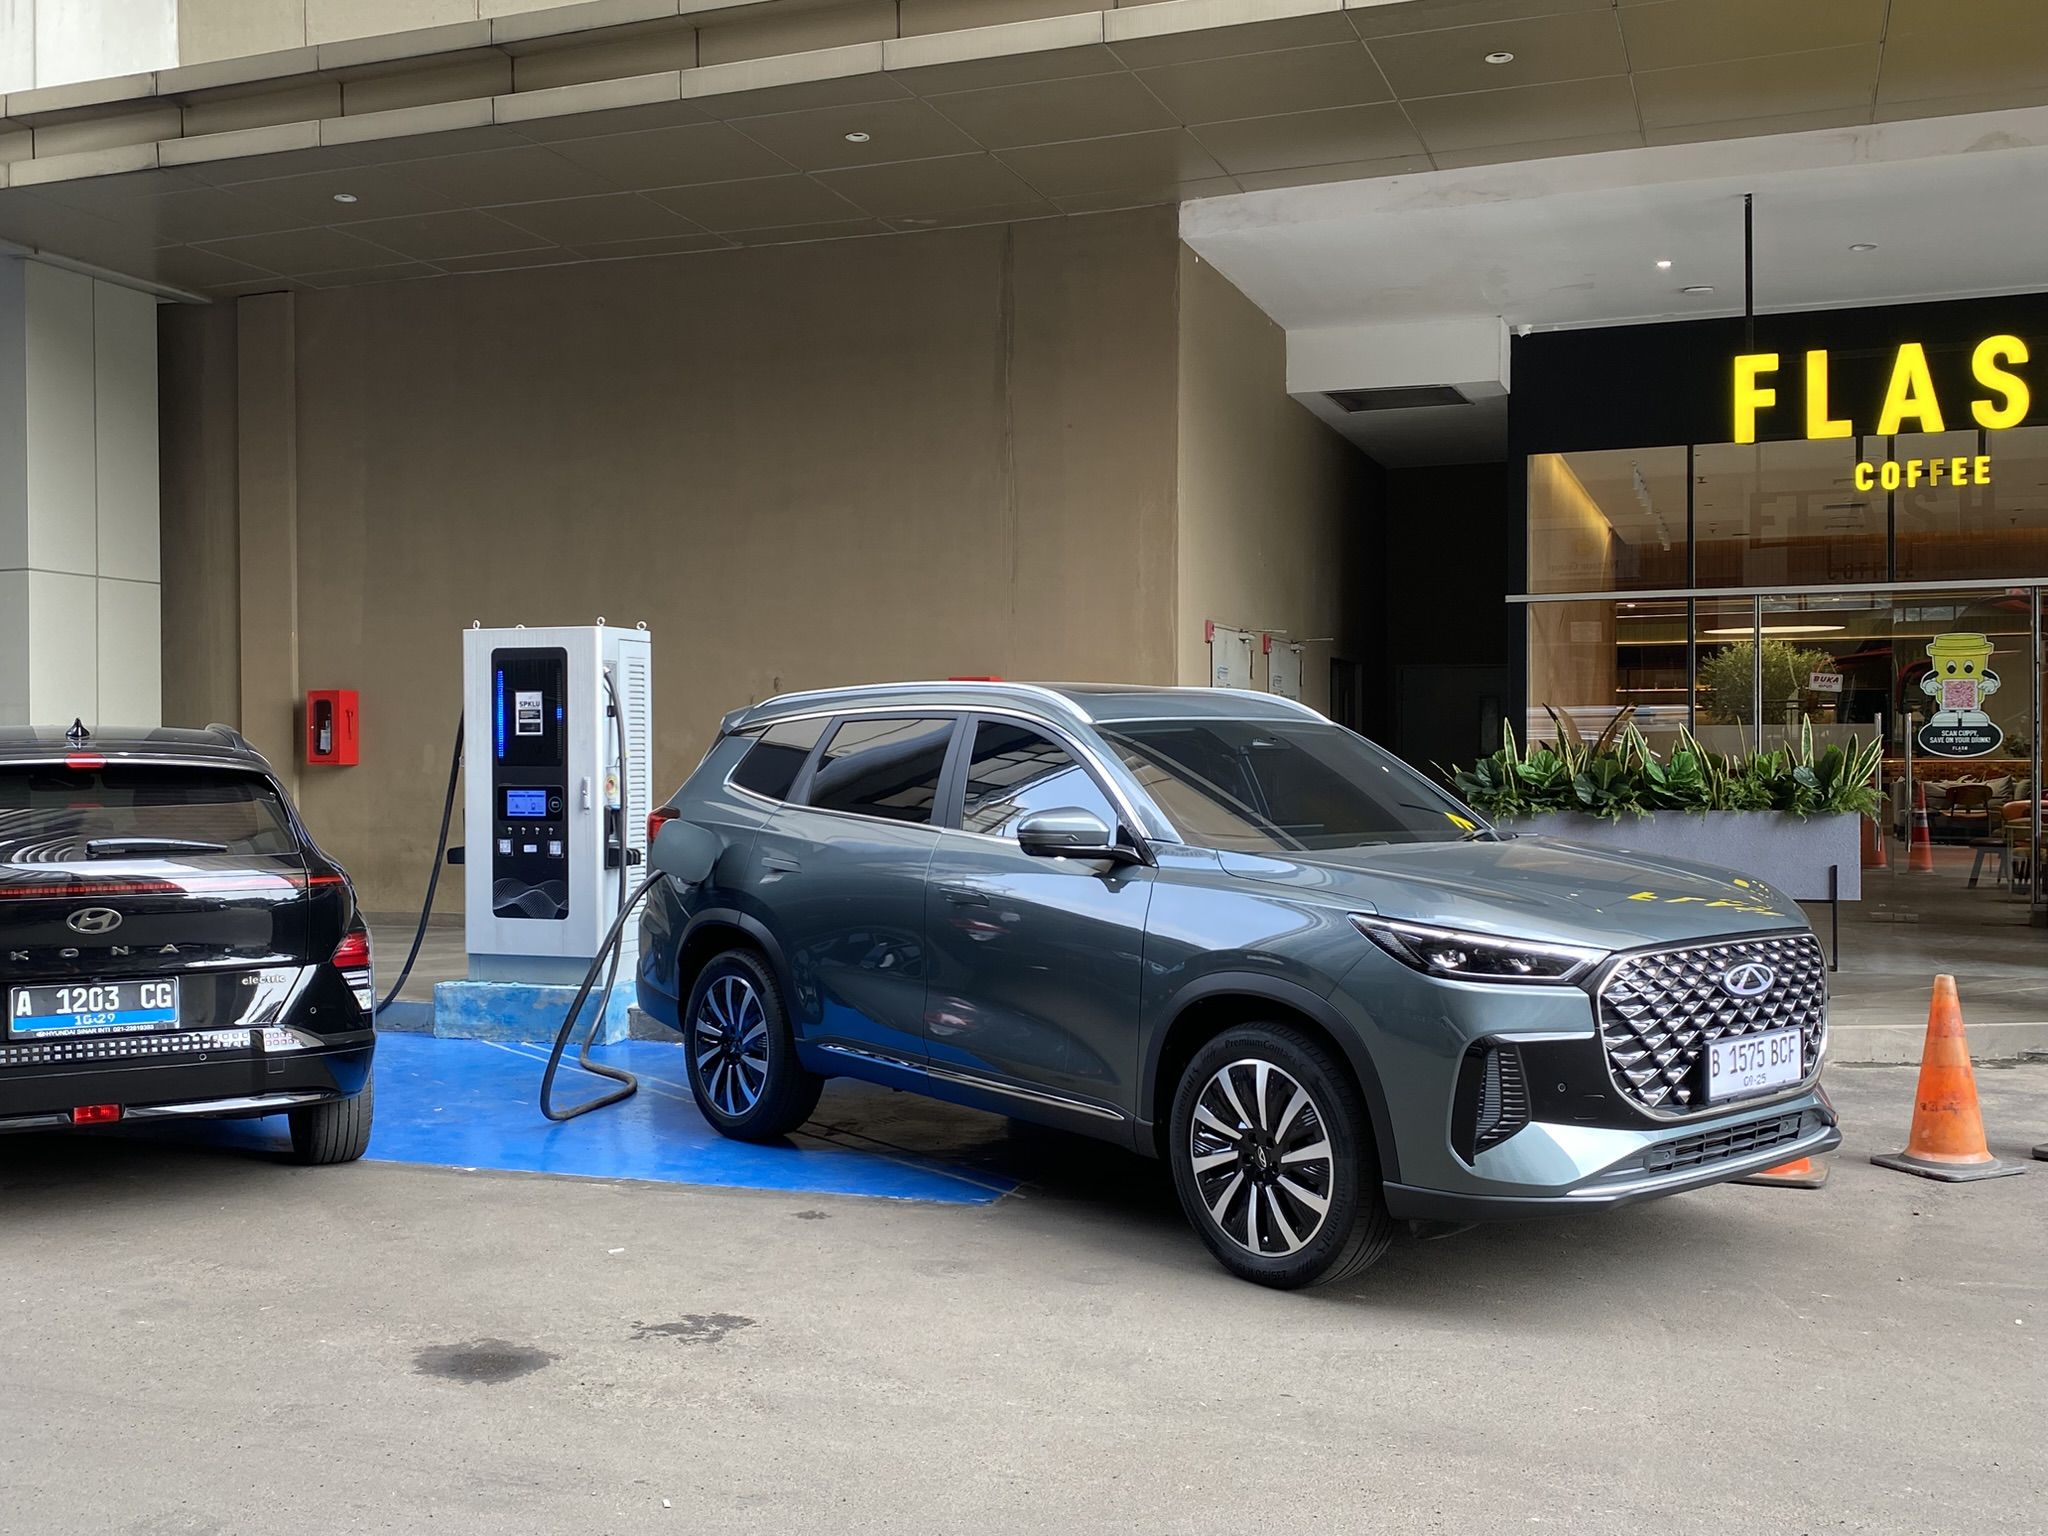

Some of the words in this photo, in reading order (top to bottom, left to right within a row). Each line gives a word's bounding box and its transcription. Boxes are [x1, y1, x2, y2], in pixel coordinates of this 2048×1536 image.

[1855, 455, 1991, 491] COFFEE
[1813, 675, 1840, 684] BUKA
[10, 943, 180, 961] KONA
[241, 975, 286, 986] electric
[16, 991, 33, 1016] A
[55, 986, 120, 1014] 1203
[140, 983, 173, 1009] CG
[76, 1027, 97, 1035] SINAR
[1712, 1049, 1720, 1078] B
[1729, 1041, 1765, 1074] 1575
[1771, 1035, 1796, 1066] BCF
